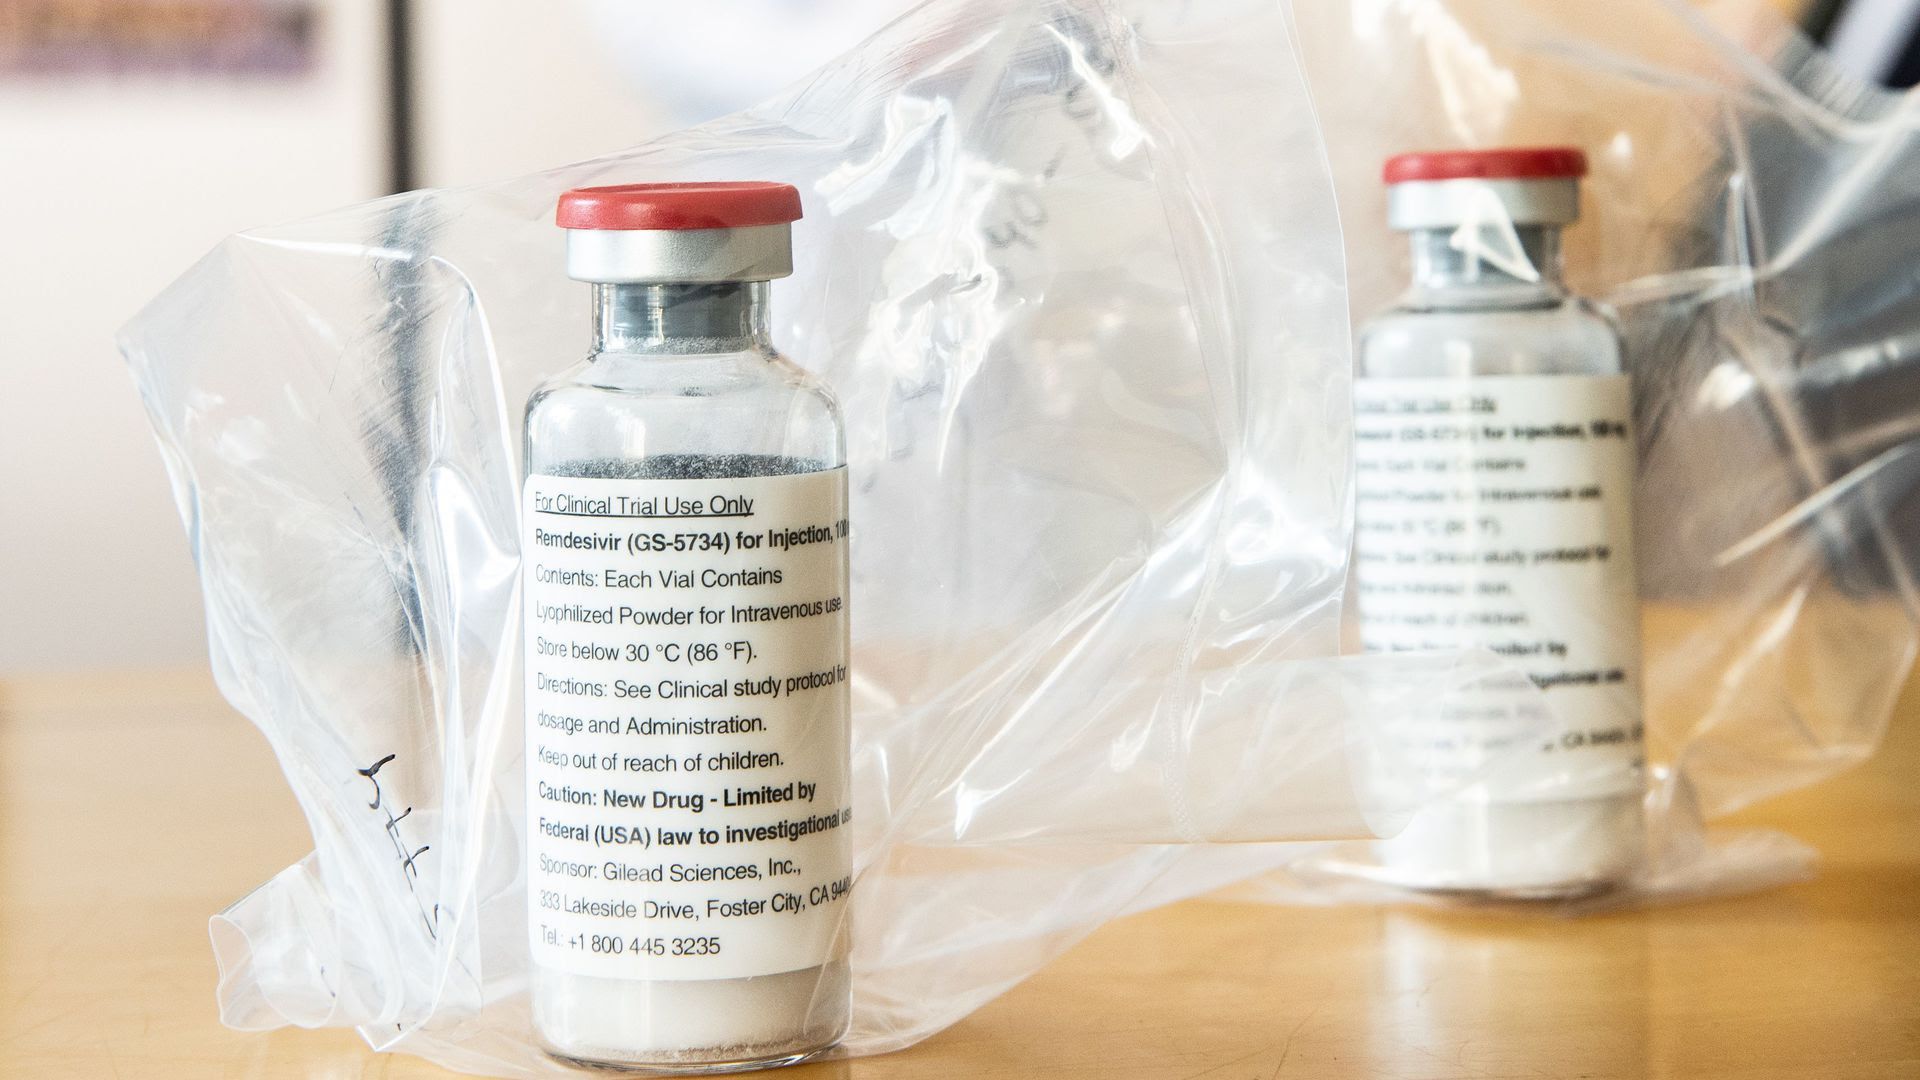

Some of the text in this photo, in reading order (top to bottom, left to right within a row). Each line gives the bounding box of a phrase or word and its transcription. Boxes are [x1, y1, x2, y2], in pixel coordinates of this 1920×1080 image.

[536, 492, 754, 515] For Clinical Trial Use Only
[536, 528, 621, 552] Remdesivir
[628, 532, 730, 554] (GS-5734)
[736, 531, 763, 549] for
[768, 523, 833, 550] Injection,
[536, 564, 782, 588] Contents: Each Vial Contains
[536, 600, 612, 625] Lyophilized
[620, 606, 693, 625] Powder
[699, 606, 725, 624] for
[732, 601, 823, 623] Intravenous
[537, 637, 757, 665] Store below 30 °C (86 °F).
[538, 664, 846, 698] Directions: See Clinical study protocol for
[538, 709, 767, 735] dosage and Administration.
[538, 745, 784, 772] Keep out of reach of children.
[539, 781, 597, 805] Caution:
[603, 789, 646, 808] New
[653, 790, 704, 813] Drug
[724, 783, 793, 807] Limited
[798, 781, 816, 801] by
[539, 817, 588, 842] Federal
[595, 825, 650, 849] (USA)
[658, 827, 691, 845] law
[699, 827, 719, 844] to
[726, 810, 840, 844] investigational
[539, 853, 801, 883] Sponsor: Gilead Sciences, Inc.,
[539, 890, 560, 910] 333
[564, 894, 637, 918] Lakeside
[644, 900, 700, 921] Drive,
[707, 898, 766, 919] Foster
[772, 891, 806, 912] City,
[810, 884, 829, 906] CA
[568, 934, 584, 949] +1
[592, 935, 622, 954] 800
[630, 938, 665, 955] 445
[672, 937, 720, 955] 3235
